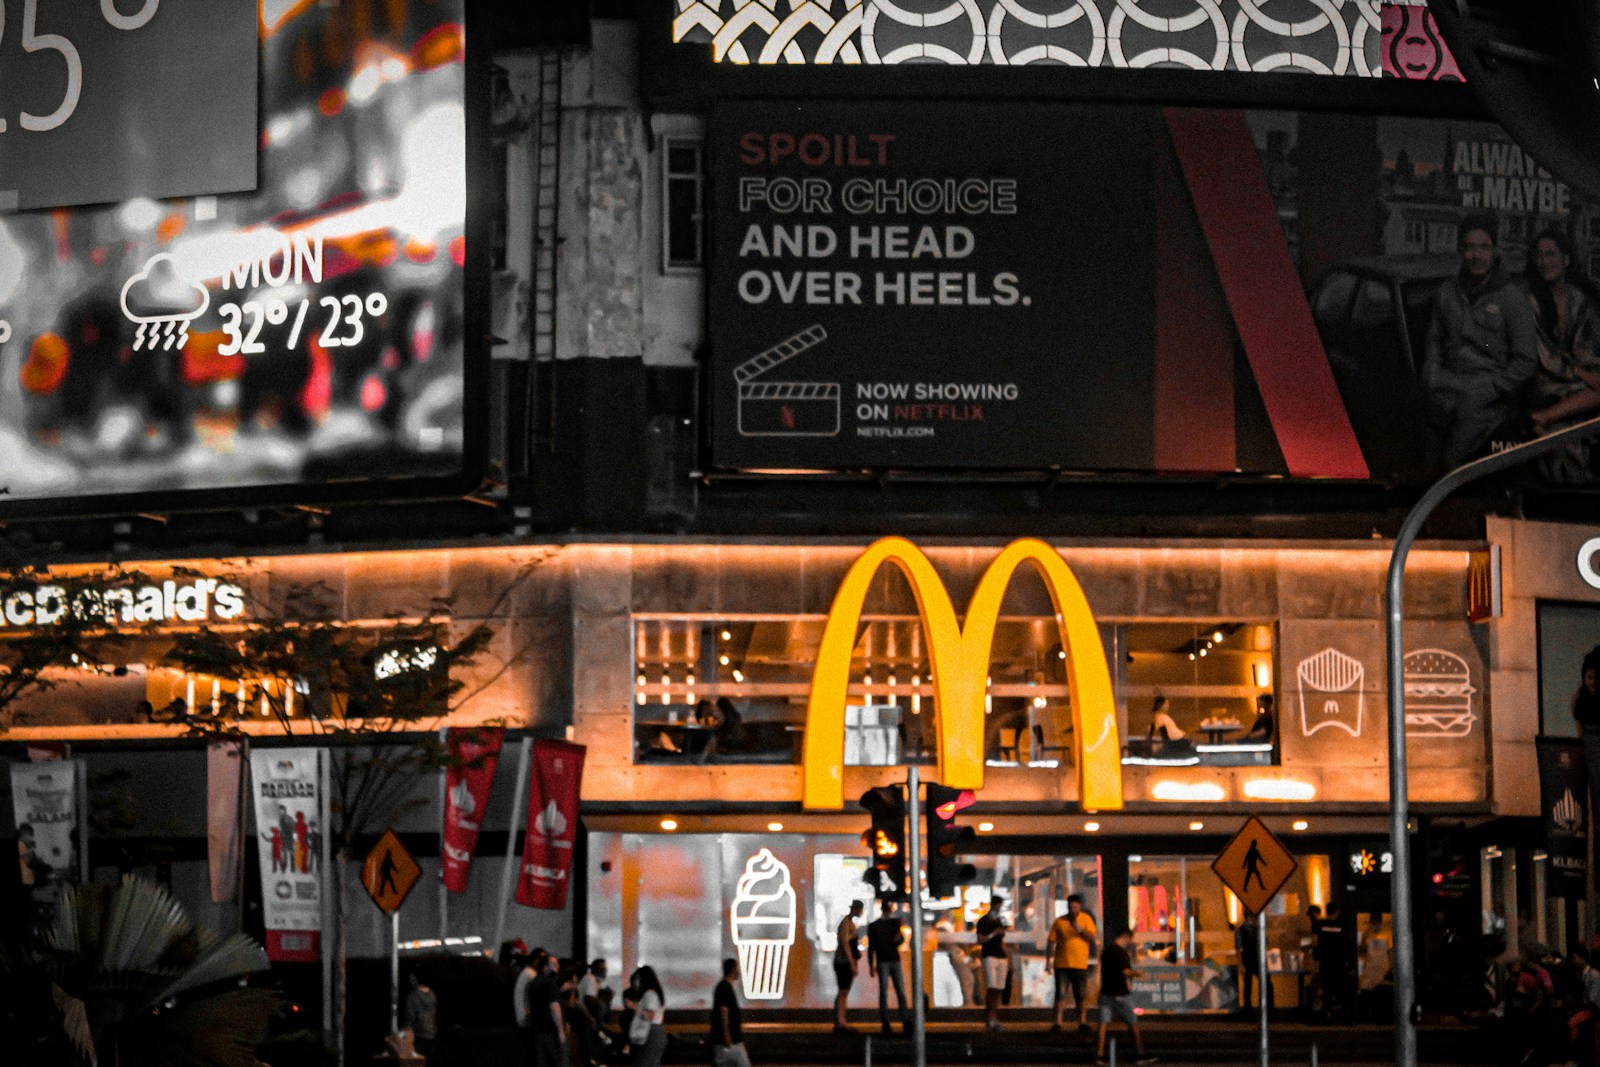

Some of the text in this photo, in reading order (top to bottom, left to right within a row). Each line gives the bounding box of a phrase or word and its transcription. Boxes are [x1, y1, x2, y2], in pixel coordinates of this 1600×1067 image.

[739, 133, 897, 167] SPOILT
[1453, 141, 1553, 179] ALWA
[738, 177, 1018, 214] FOR CHOICE
[1483, 176, 1571, 215] MAYBE
[738, 223, 976, 259] AND HEAD
[221, 231, 325, 291] MON
[737, 270, 1032, 306] OVER HEELS.
[856, 383, 1019, 400] NOW SHOWING
[856, 403, 985, 421] ON NETFLIX
[856, 427, 935, 437] NETFLIX.COM
[0, 578, 245, 627] cDnald's
